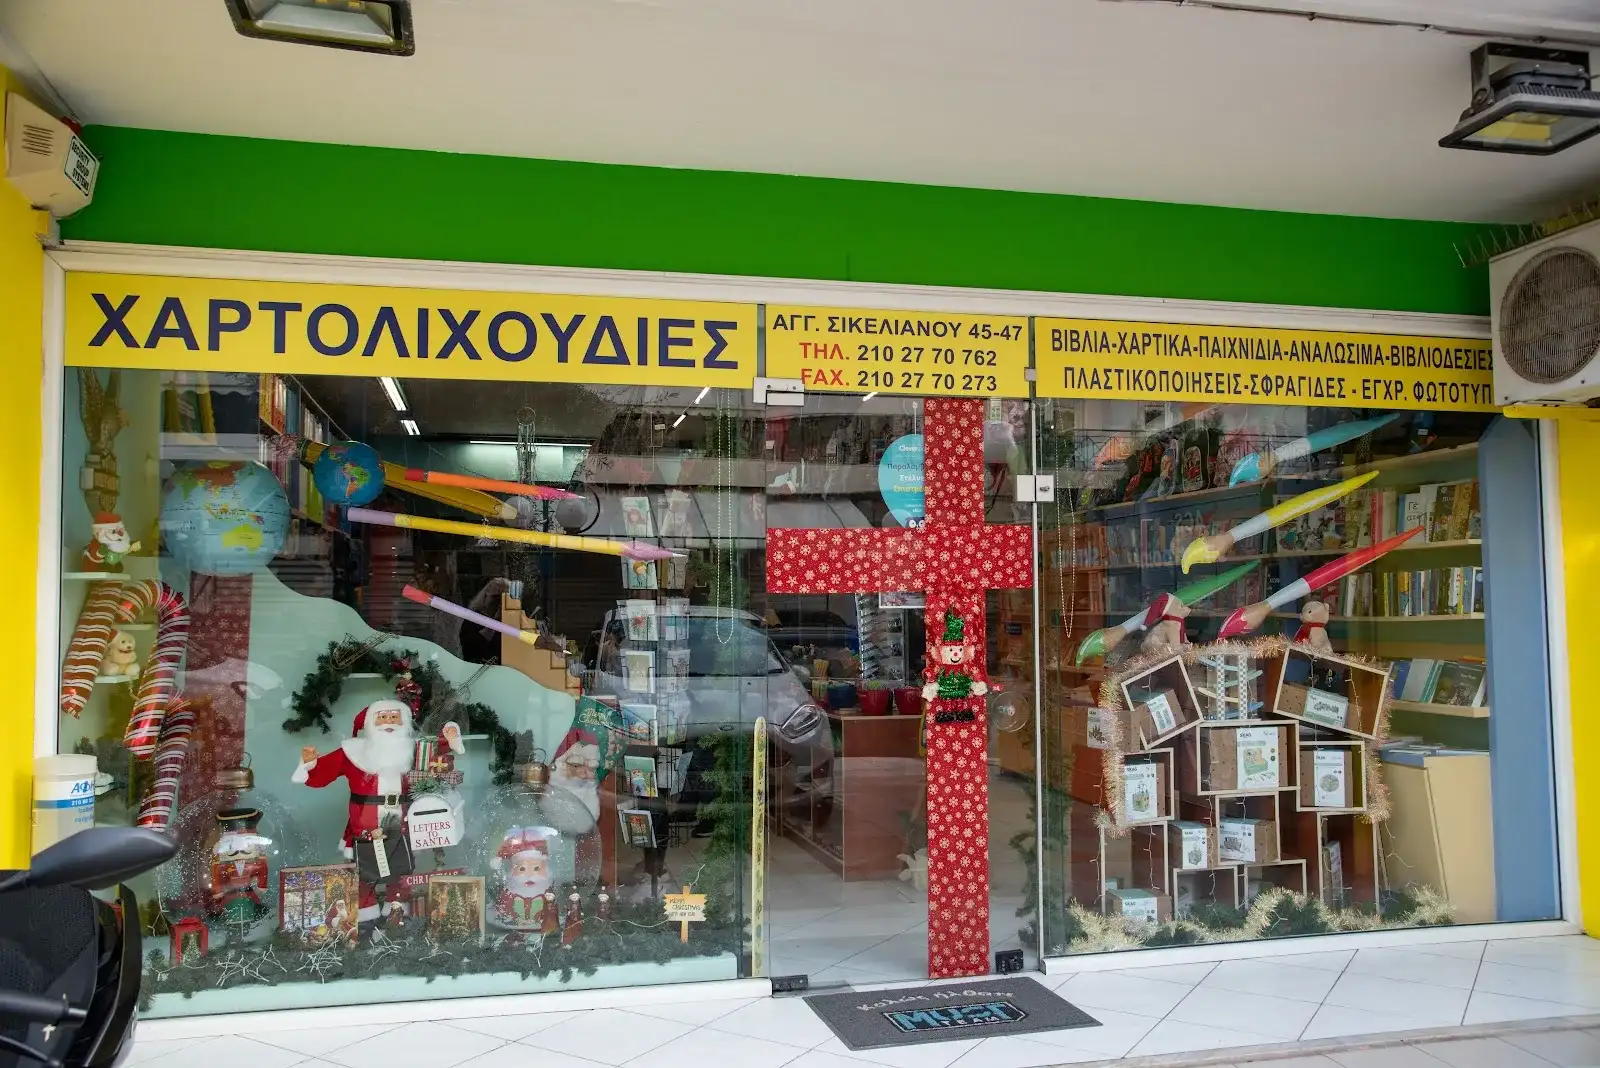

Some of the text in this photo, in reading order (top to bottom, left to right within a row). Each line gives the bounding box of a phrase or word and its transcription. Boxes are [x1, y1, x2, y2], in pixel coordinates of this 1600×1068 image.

[88, 293, 739, 370] ΧΑΡΤΟΛΙΧΟΥΔΙΕΣ
[773, 313, 1023, 341] ΑΓΓ. ΣΙΚΕΛΙΑΝΟΥ 45-47
[799, 342, 997, 366] ΤΗΛ. 210 27 70 762
[800, 368, 997, 391] FAX. 210 27 70 273
[1362, 379, 1407, 401] ΕΓΧΡ.
[413, 821, 451, 833] LETTERS
[427, 830, 438, 838] TO
[415, 836, 451, 848] SANTA
[892, 1003, 1012, 1029] MUST
